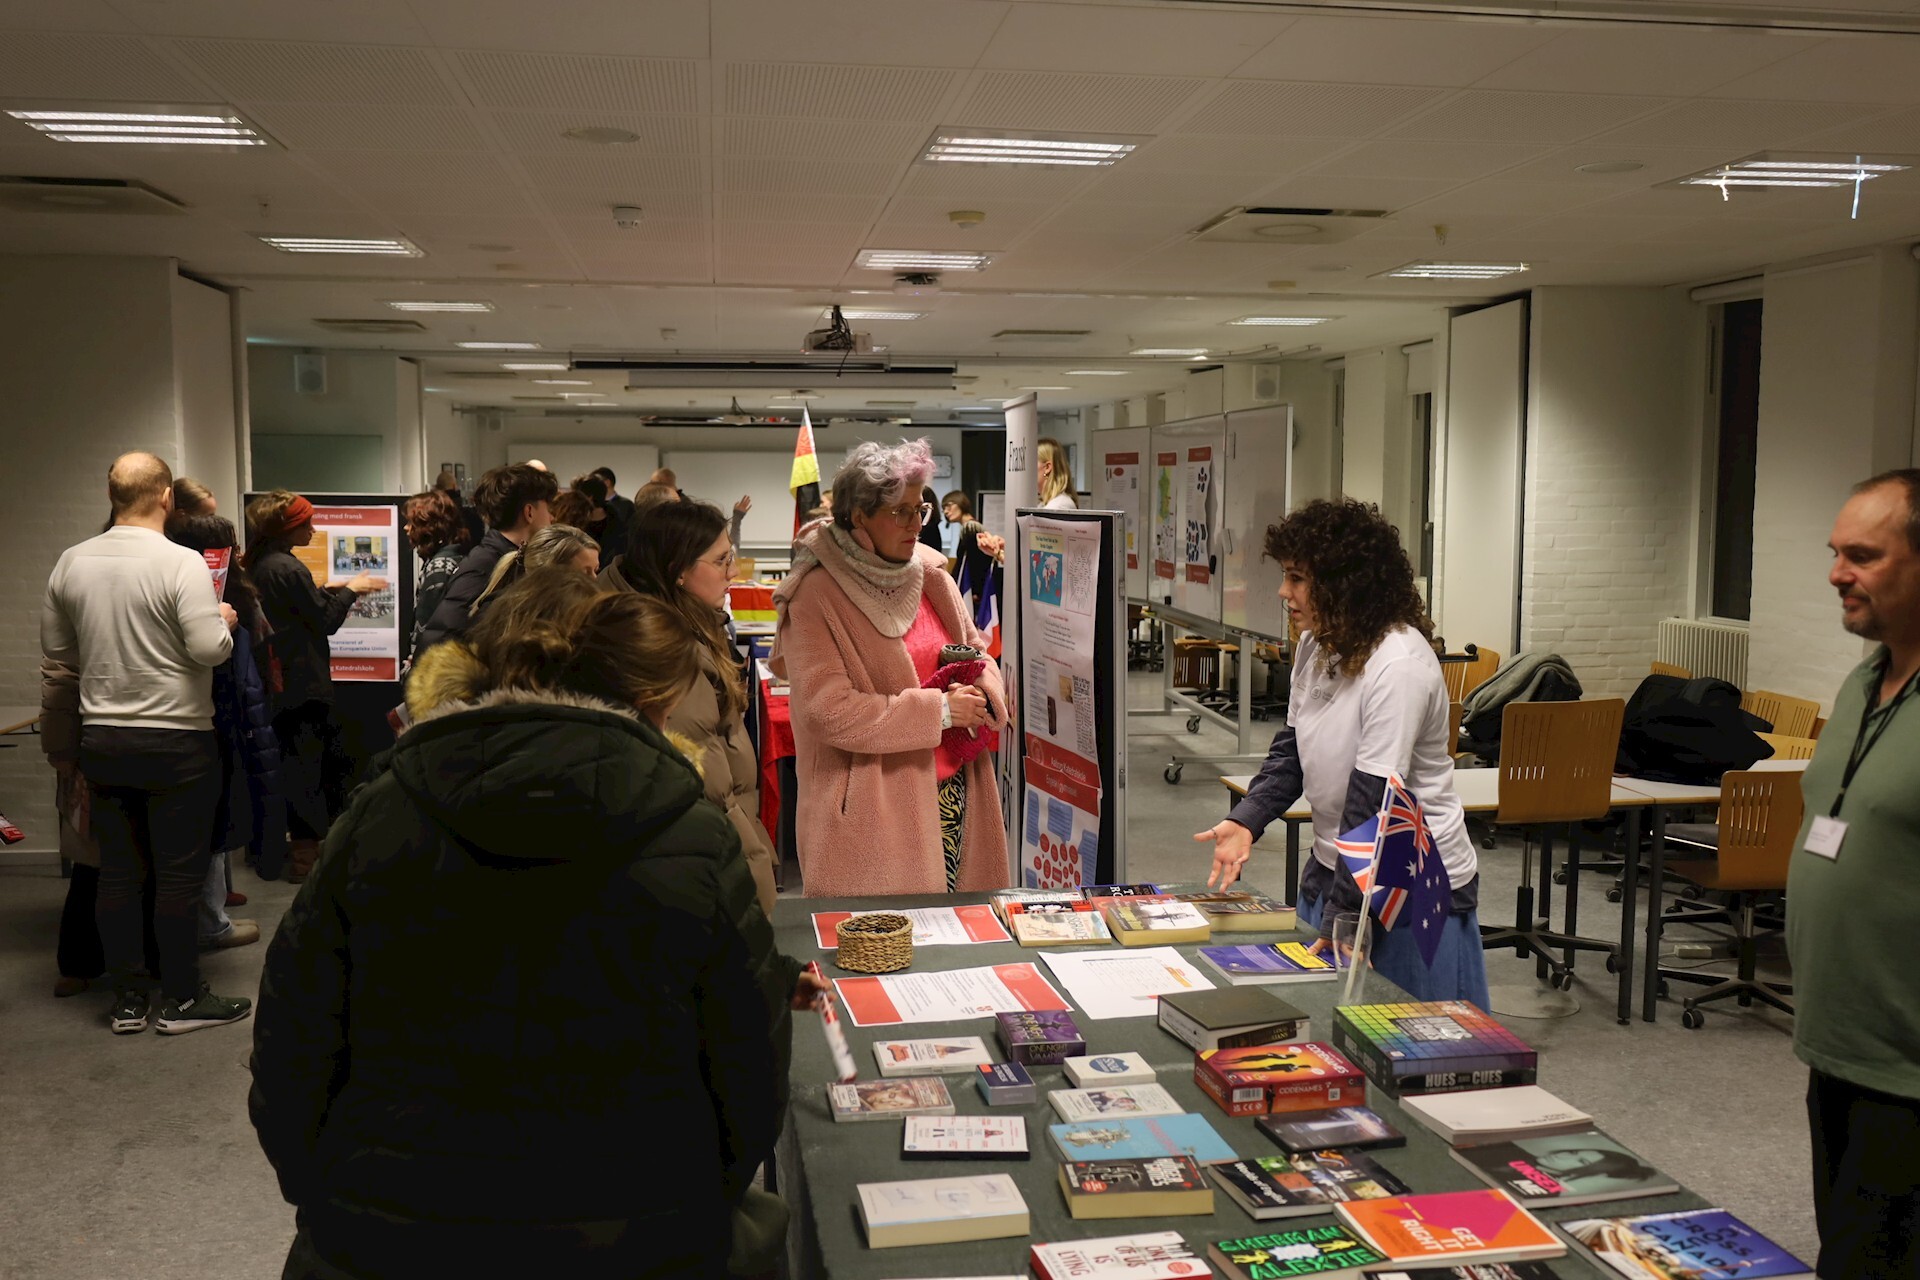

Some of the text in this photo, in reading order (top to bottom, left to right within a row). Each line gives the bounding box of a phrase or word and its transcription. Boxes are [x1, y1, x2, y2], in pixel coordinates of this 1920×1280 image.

[1009, 437, 1026, 472] Fransk
[1029, 1043, 1068, 1053] ONE NIGHT
[1029, 1052, 1067, 1060] VAMPIRE
[1305, 1043, 1349, 1074] CODENAMES
[1279, 1084, 1323, 1095] CODENAMES
[1425, 1072, 1456, 1088] HUES
[1472, 1070, 1503, 1085] CUES
[1508, 1160, 1566, 1193] UNSEX
[1513, 1180, 1548, 1195] ME
[1218, 1226, 1344, 1251] SHERMAN
[1400, 1219, 1445, 1251] RIGHT
[1440, 1238, 1465, 1249] IT
[1451, 1227, 1485, 1247] GET
[1671, 1218, 1748, 1256] CROSS
[1093, 1255, 1114, 1264] IS
[1115, 1245, 1147, 1268] OF US
[1144, 1245, 1173, 1261] ONE
[1641, 1224, 1741, 1276] CANADA
[1057, 1250, 1090, 1276] LYING
[1250, 1248, 1381, 1279] ALEXIE
